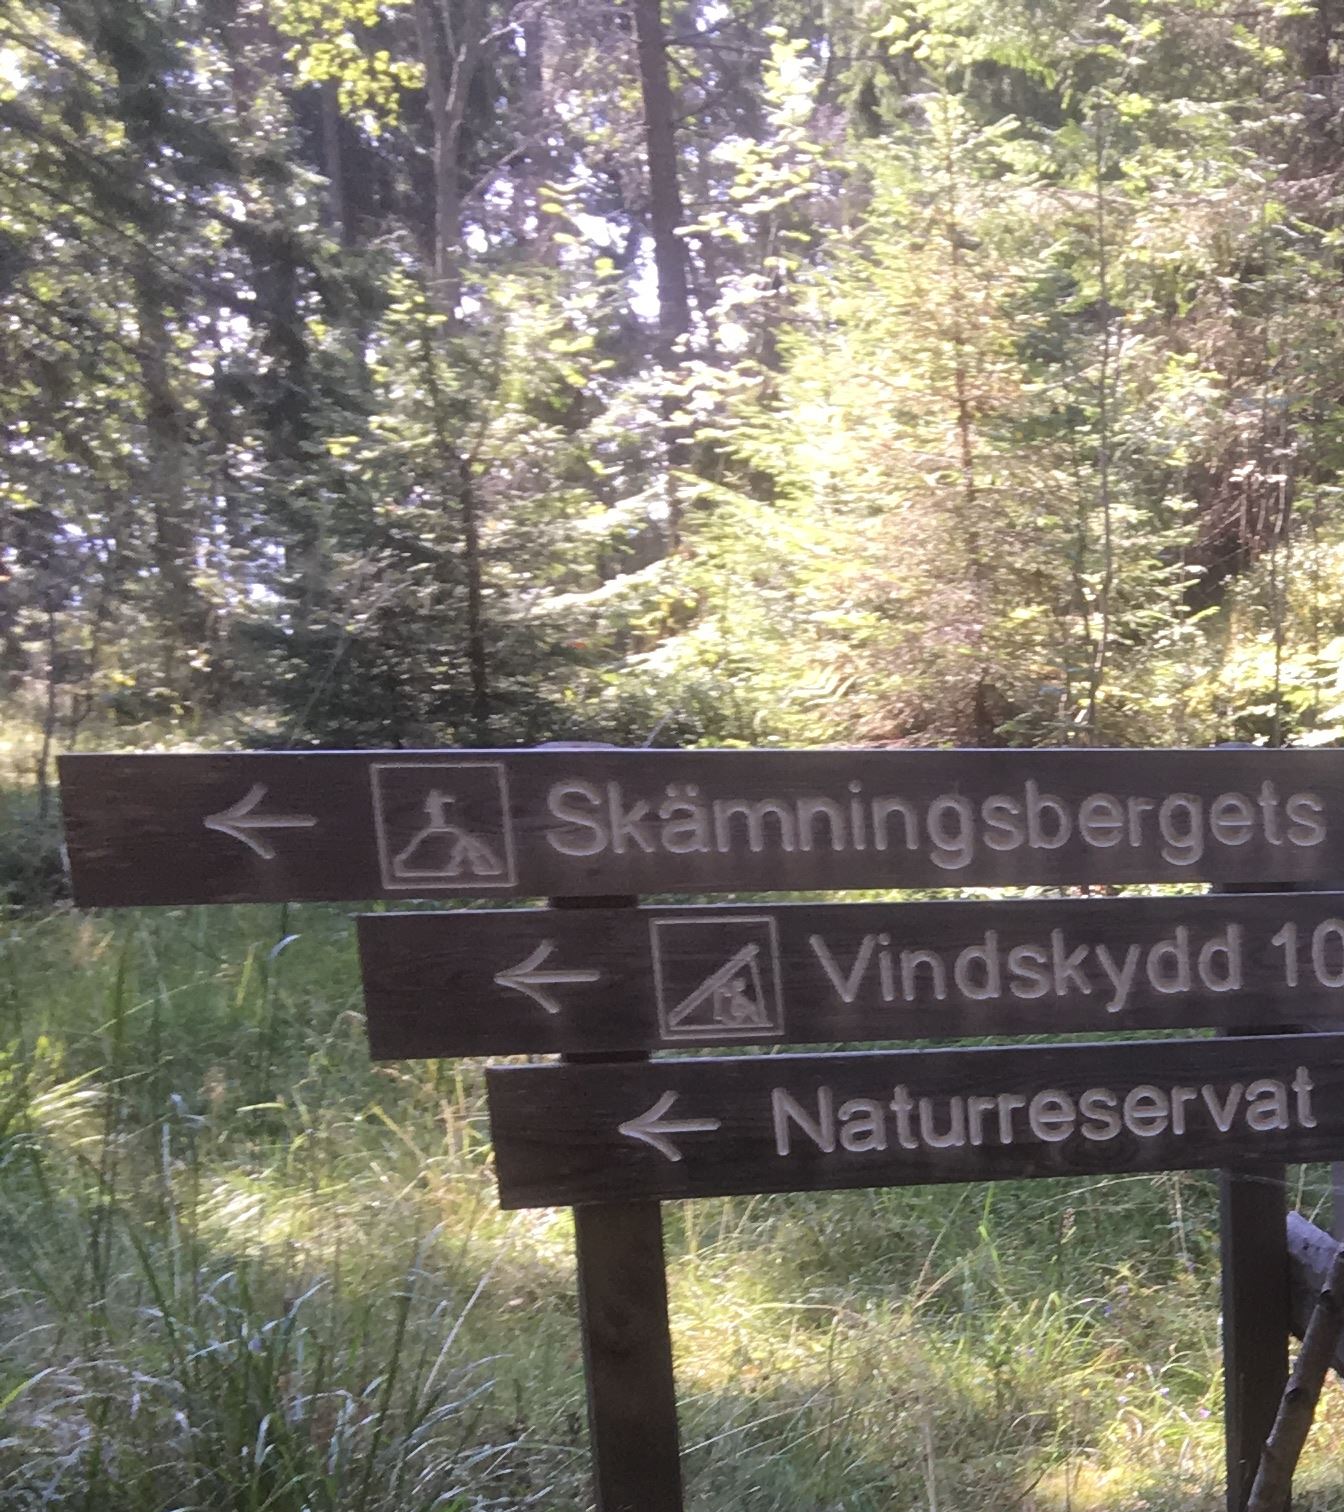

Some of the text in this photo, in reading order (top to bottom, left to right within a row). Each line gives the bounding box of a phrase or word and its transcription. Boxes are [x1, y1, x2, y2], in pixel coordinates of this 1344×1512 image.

[546, 779, 1327, 869] Skämningsbergets
[809, 923, 1243, 1013] Vindskydd
[771, 1066, 1317, 1157] Naturreservat
